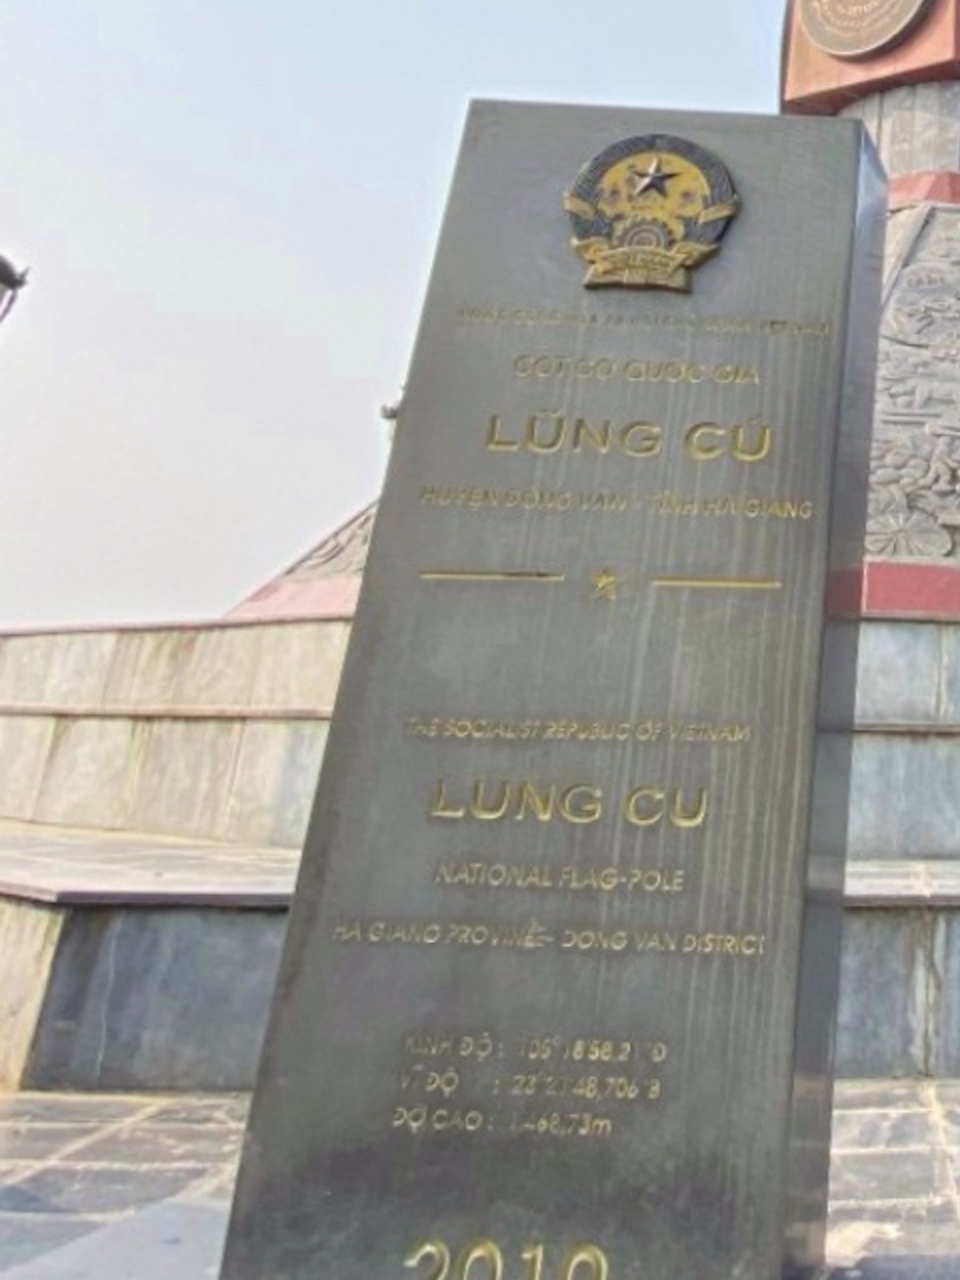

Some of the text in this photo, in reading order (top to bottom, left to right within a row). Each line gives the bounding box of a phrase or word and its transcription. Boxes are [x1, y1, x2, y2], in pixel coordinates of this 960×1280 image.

[485, 408, 664, 458] LŨNG
[428, 779, 709, 828] LUNG CU
[434, 862, 686, 892] NATIONAL FLAG-POLE
[560, 929, 628, 951] DONG
[681, 932, 766, 956] DISTRICT
